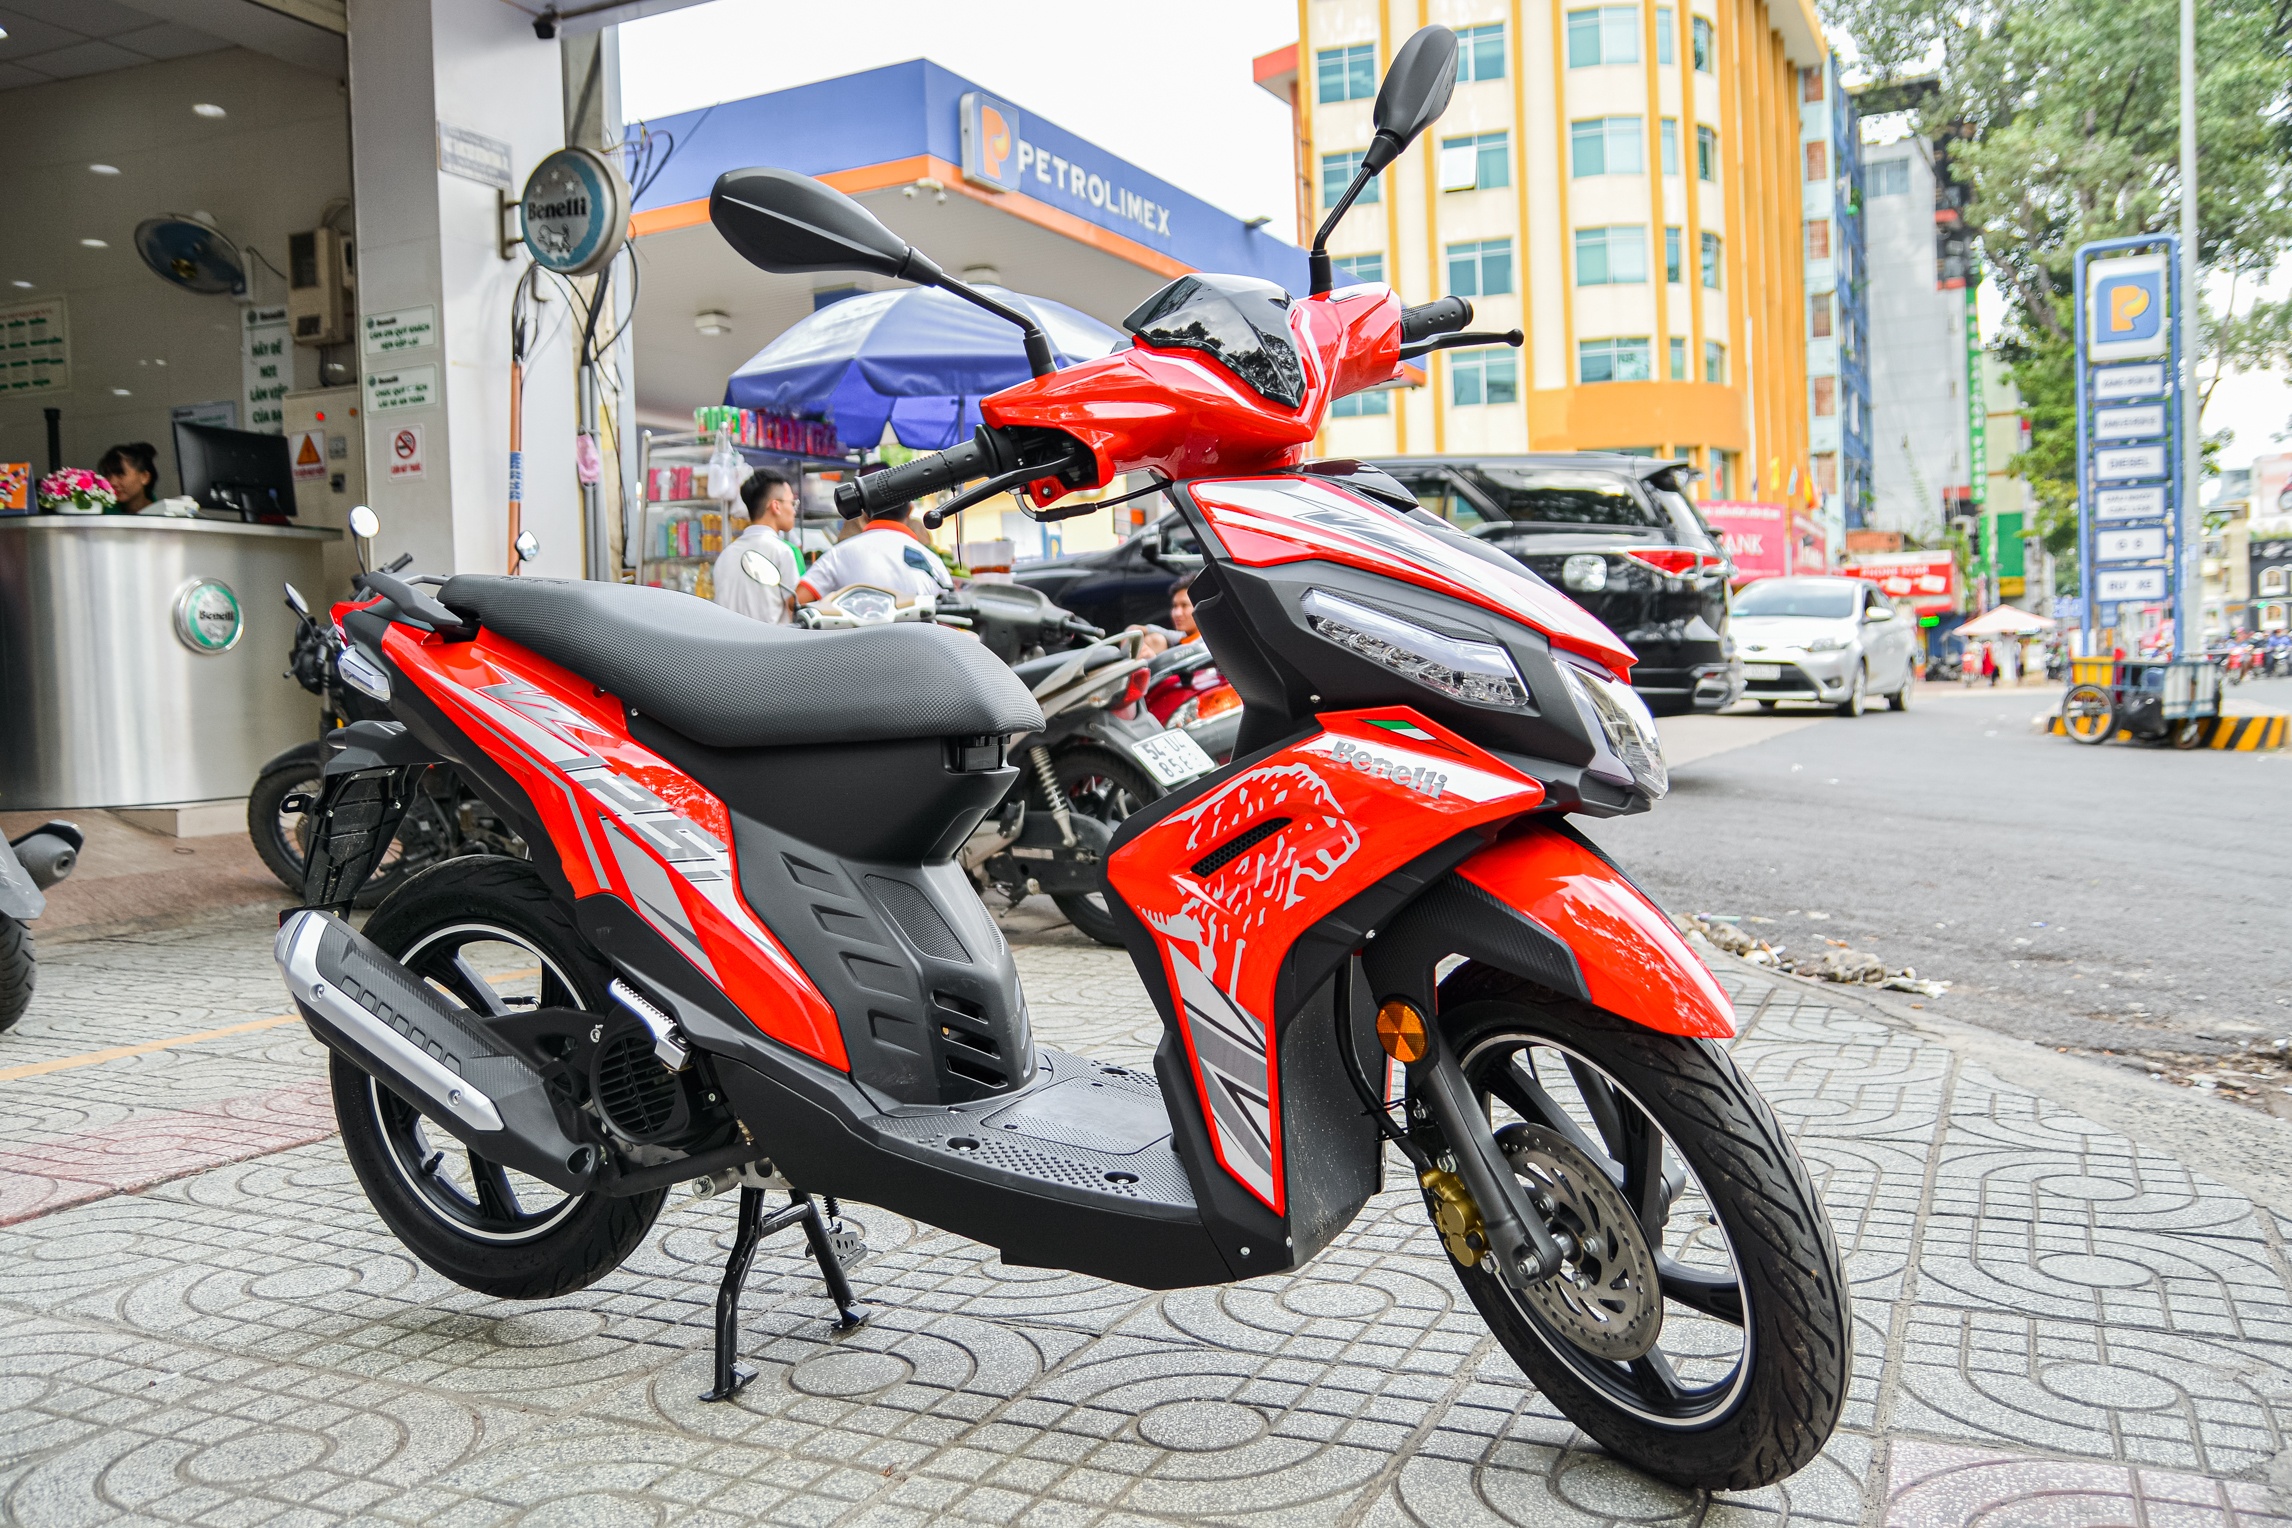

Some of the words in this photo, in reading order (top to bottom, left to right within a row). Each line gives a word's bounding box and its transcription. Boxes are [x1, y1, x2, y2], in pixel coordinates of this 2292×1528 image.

[527, 197, 588, 221] Benelli
[1017, 139, 1171, 237] PETROLIMEX
[1329, 738, 1448, 799] Benelli
